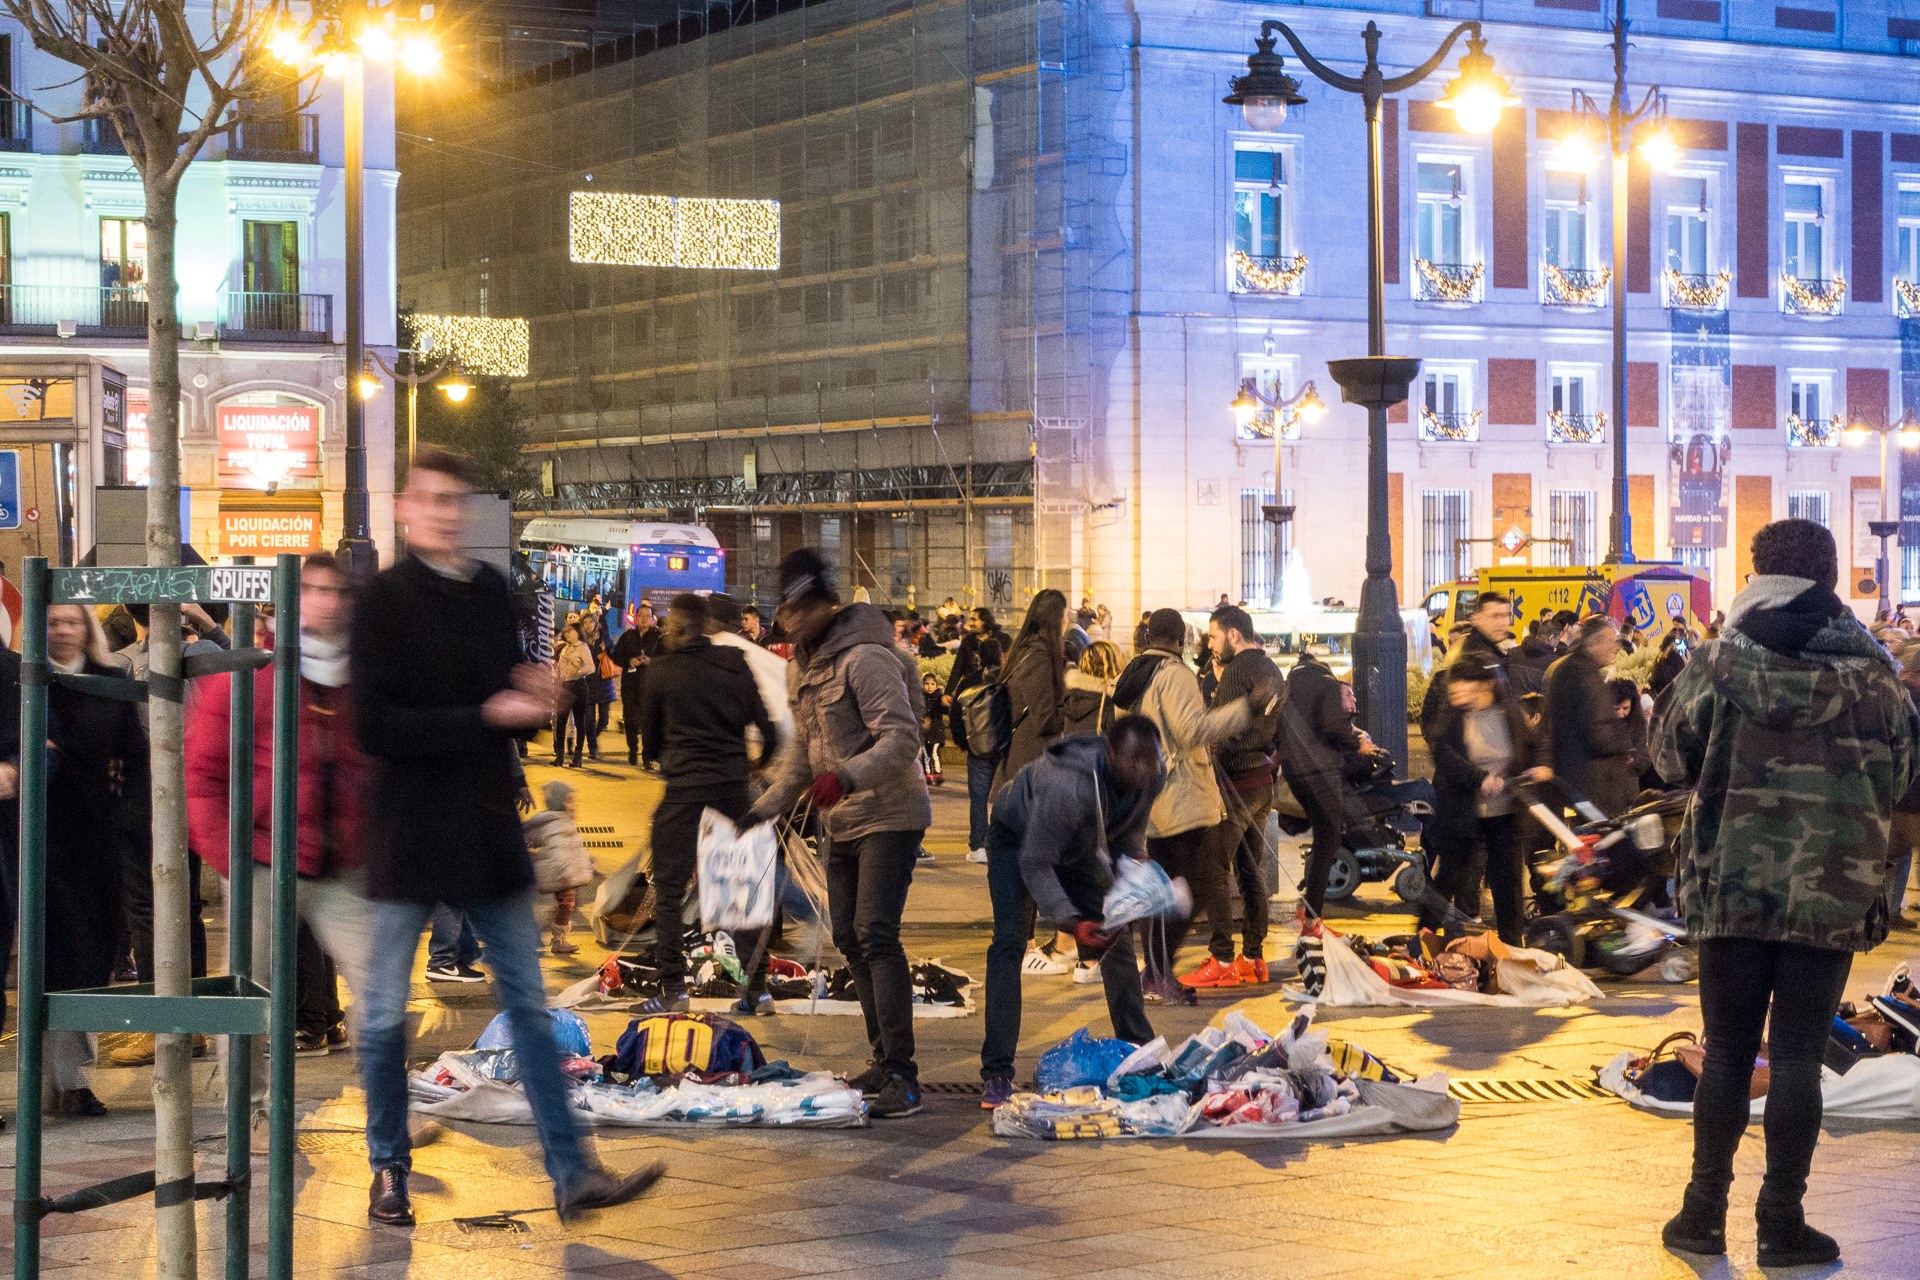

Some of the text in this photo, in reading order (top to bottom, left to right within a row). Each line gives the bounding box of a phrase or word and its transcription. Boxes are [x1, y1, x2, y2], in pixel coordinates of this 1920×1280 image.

[224, 412, 310, 431] LIQUIDACIÓN
[246, 433, 288, 449] TOTAL
[226, 515, 313, 532] LIQUIDACIÓN
[229, 534, 310, 548] POR CIERRE
[213, 571, 268, 599] SPUFFS
[637, 1018, 713, 1074] 10
